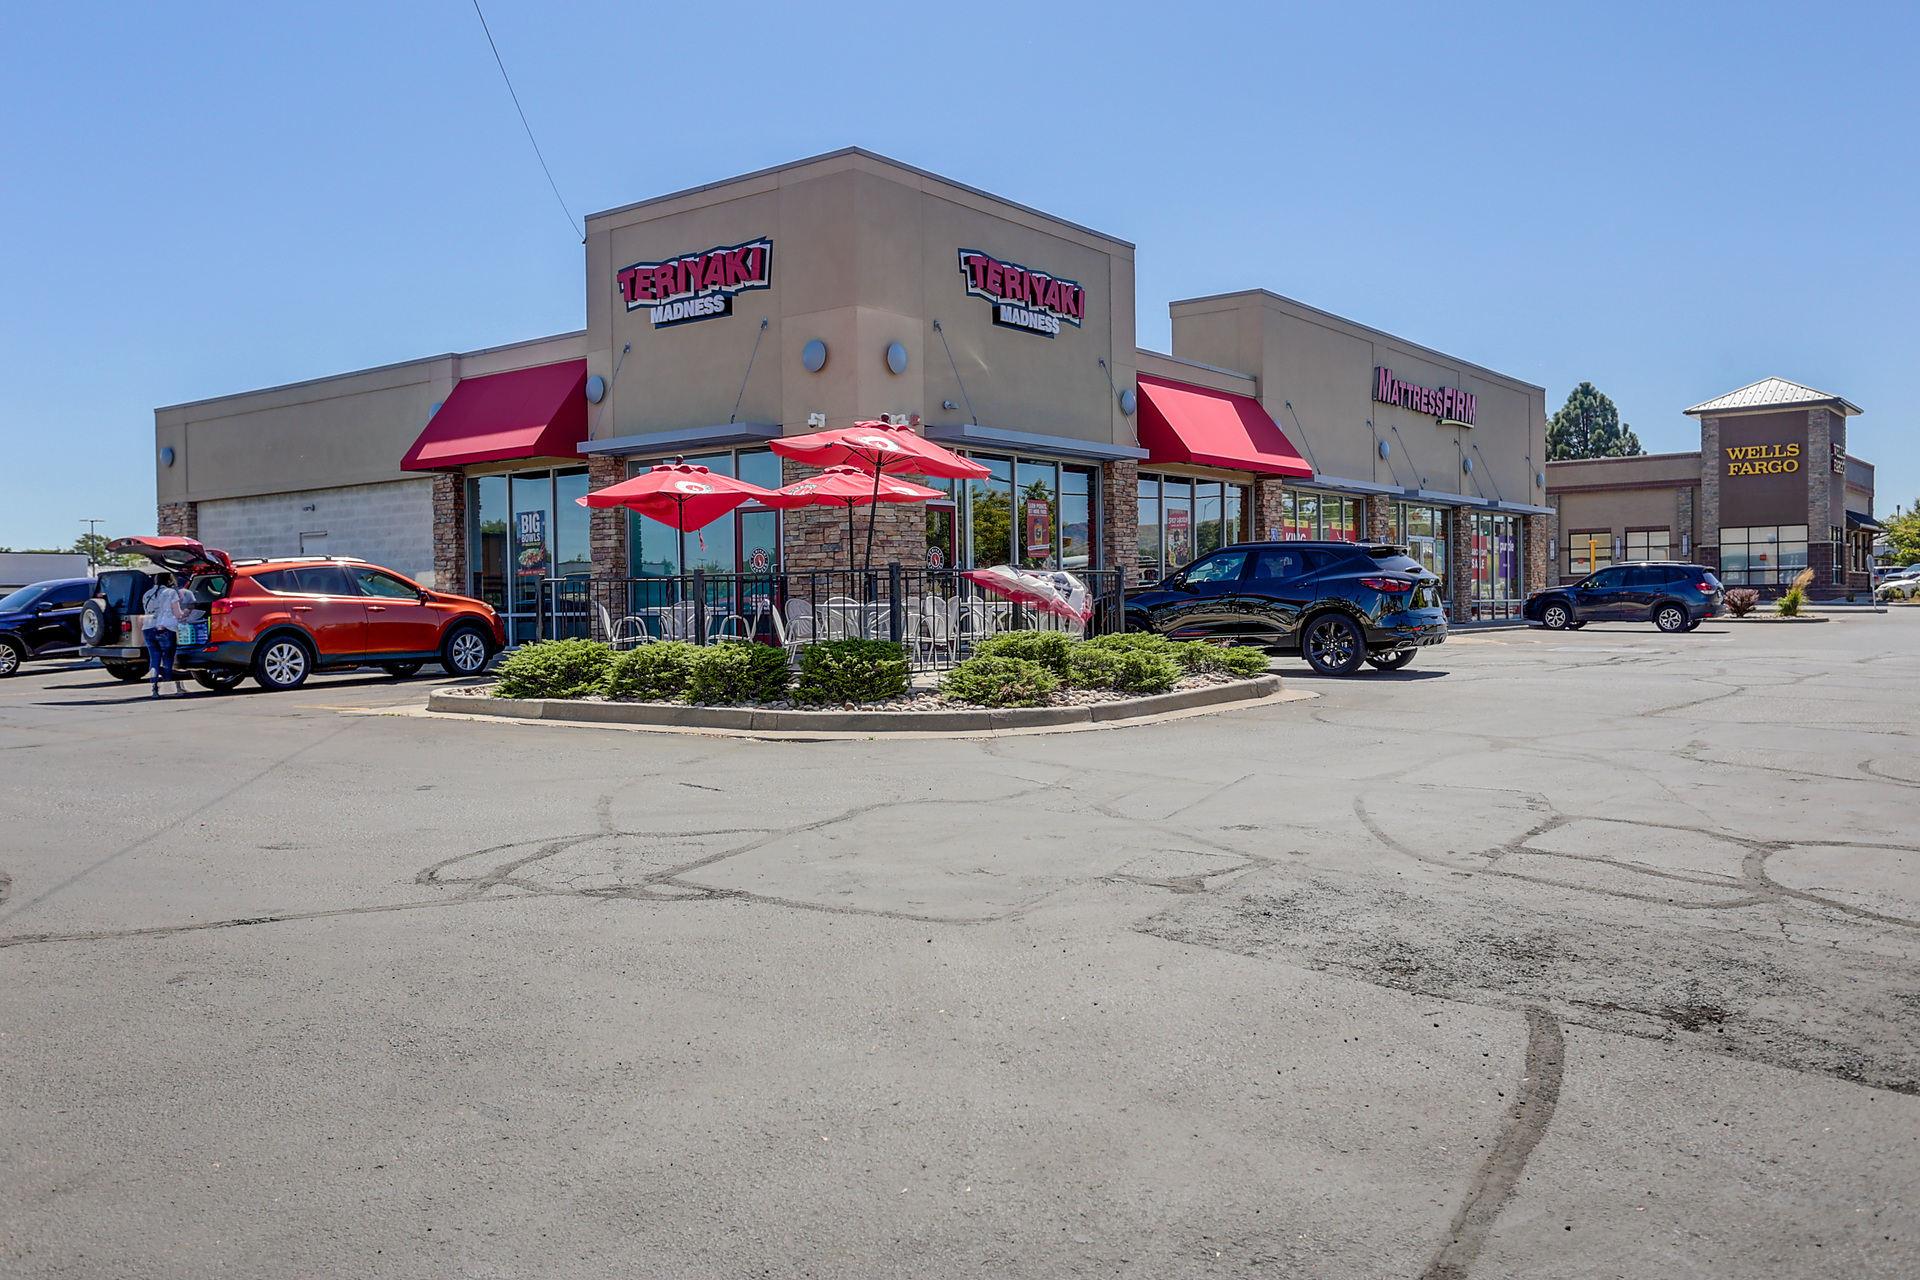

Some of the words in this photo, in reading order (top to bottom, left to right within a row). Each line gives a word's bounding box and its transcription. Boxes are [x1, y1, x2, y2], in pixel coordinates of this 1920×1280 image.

[617, 247, 764, 302] TERIYAKI
[969, 255, 1086, 320] TERIYAKI
[650, 294, 726, 325] MADNESS
[999, 305, 1061, 335] MADNESS
[1726, 442, 1801, 461] WELLS
[1727, 459, 1799, 476] FARGO
[521, 513, 541, 534] BIG
[521, 532, 541, 543] BOWLS
